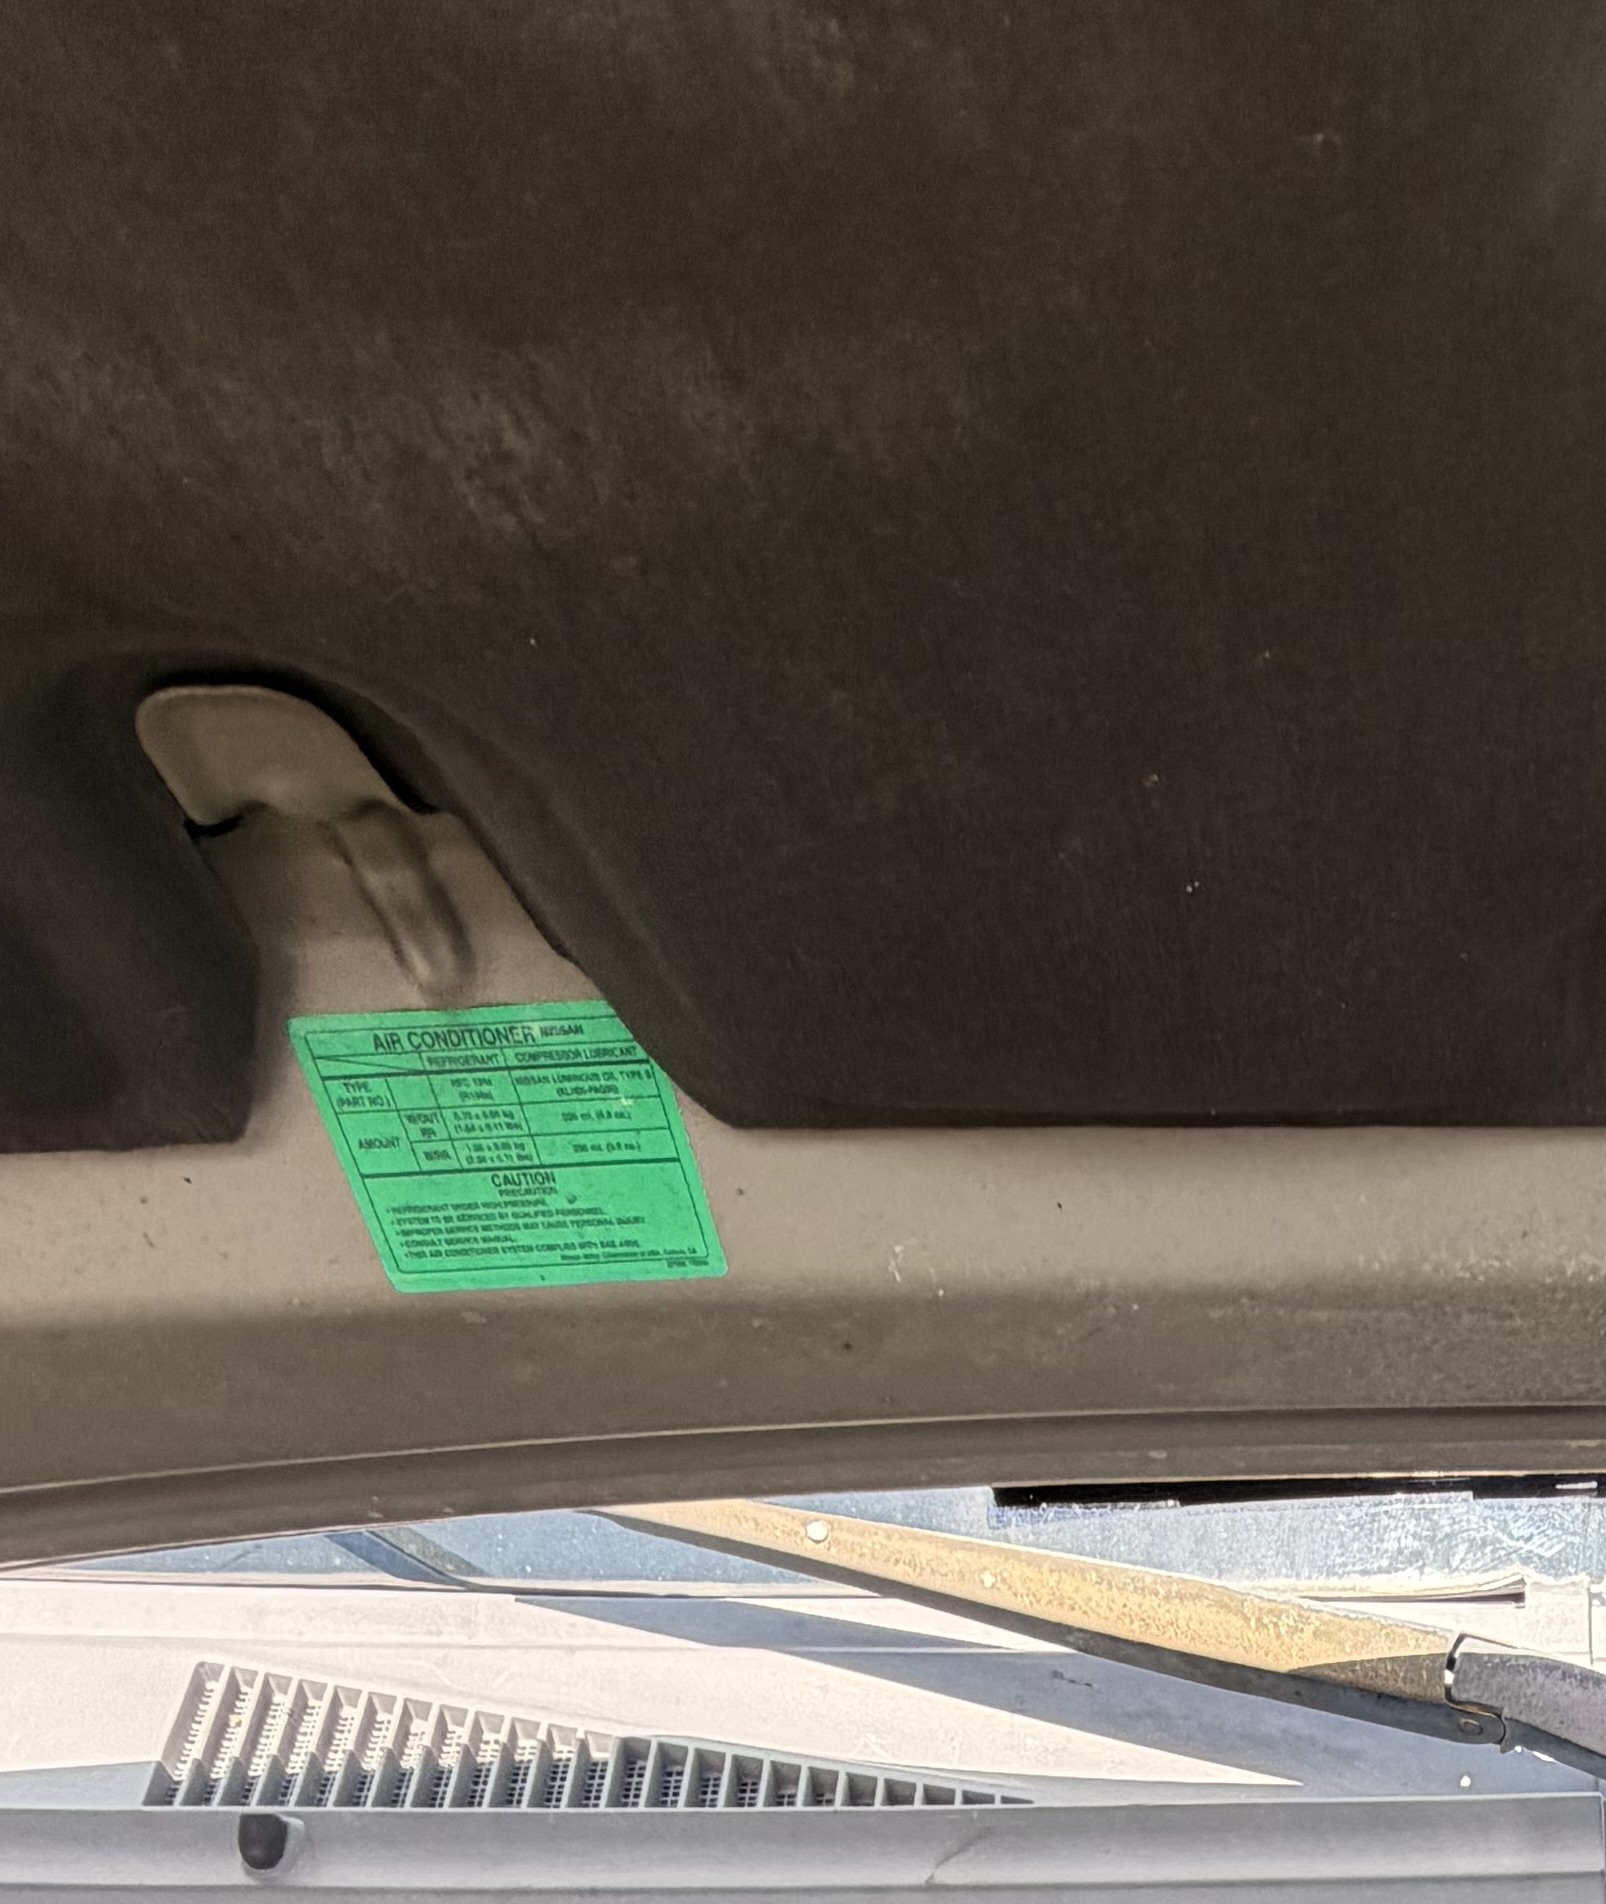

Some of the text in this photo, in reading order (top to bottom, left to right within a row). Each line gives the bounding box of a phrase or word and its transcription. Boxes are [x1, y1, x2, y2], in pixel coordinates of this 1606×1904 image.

[371, 1024, 536, 1051] AIR CONDITIONER
[424, 1052, 501, 1067] REFRIGERANT
[341, 1080, 373, 1094] TYPE
[355, 1135, 403, 1150] AMOUNT
[488, 1170, 558, 1187] CAUTION
